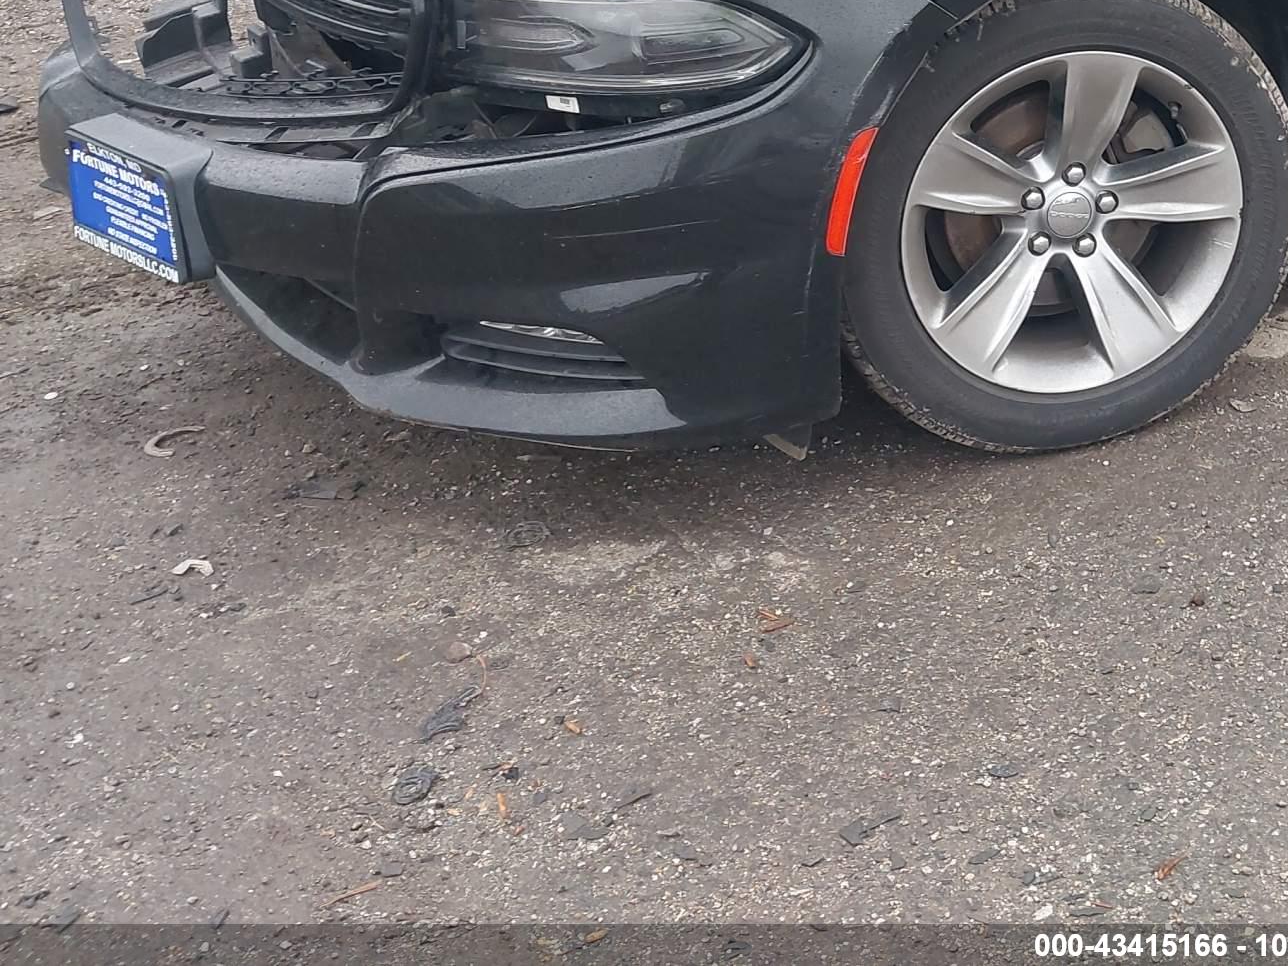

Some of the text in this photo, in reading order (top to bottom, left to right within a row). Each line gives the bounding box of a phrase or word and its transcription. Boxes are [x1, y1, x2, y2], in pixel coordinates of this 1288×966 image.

[72, 149, 160, 196] FORTUNE MOTORS
[126, 159, 142, 173] MD
[74, 225, 110, 253] FORTUNE
